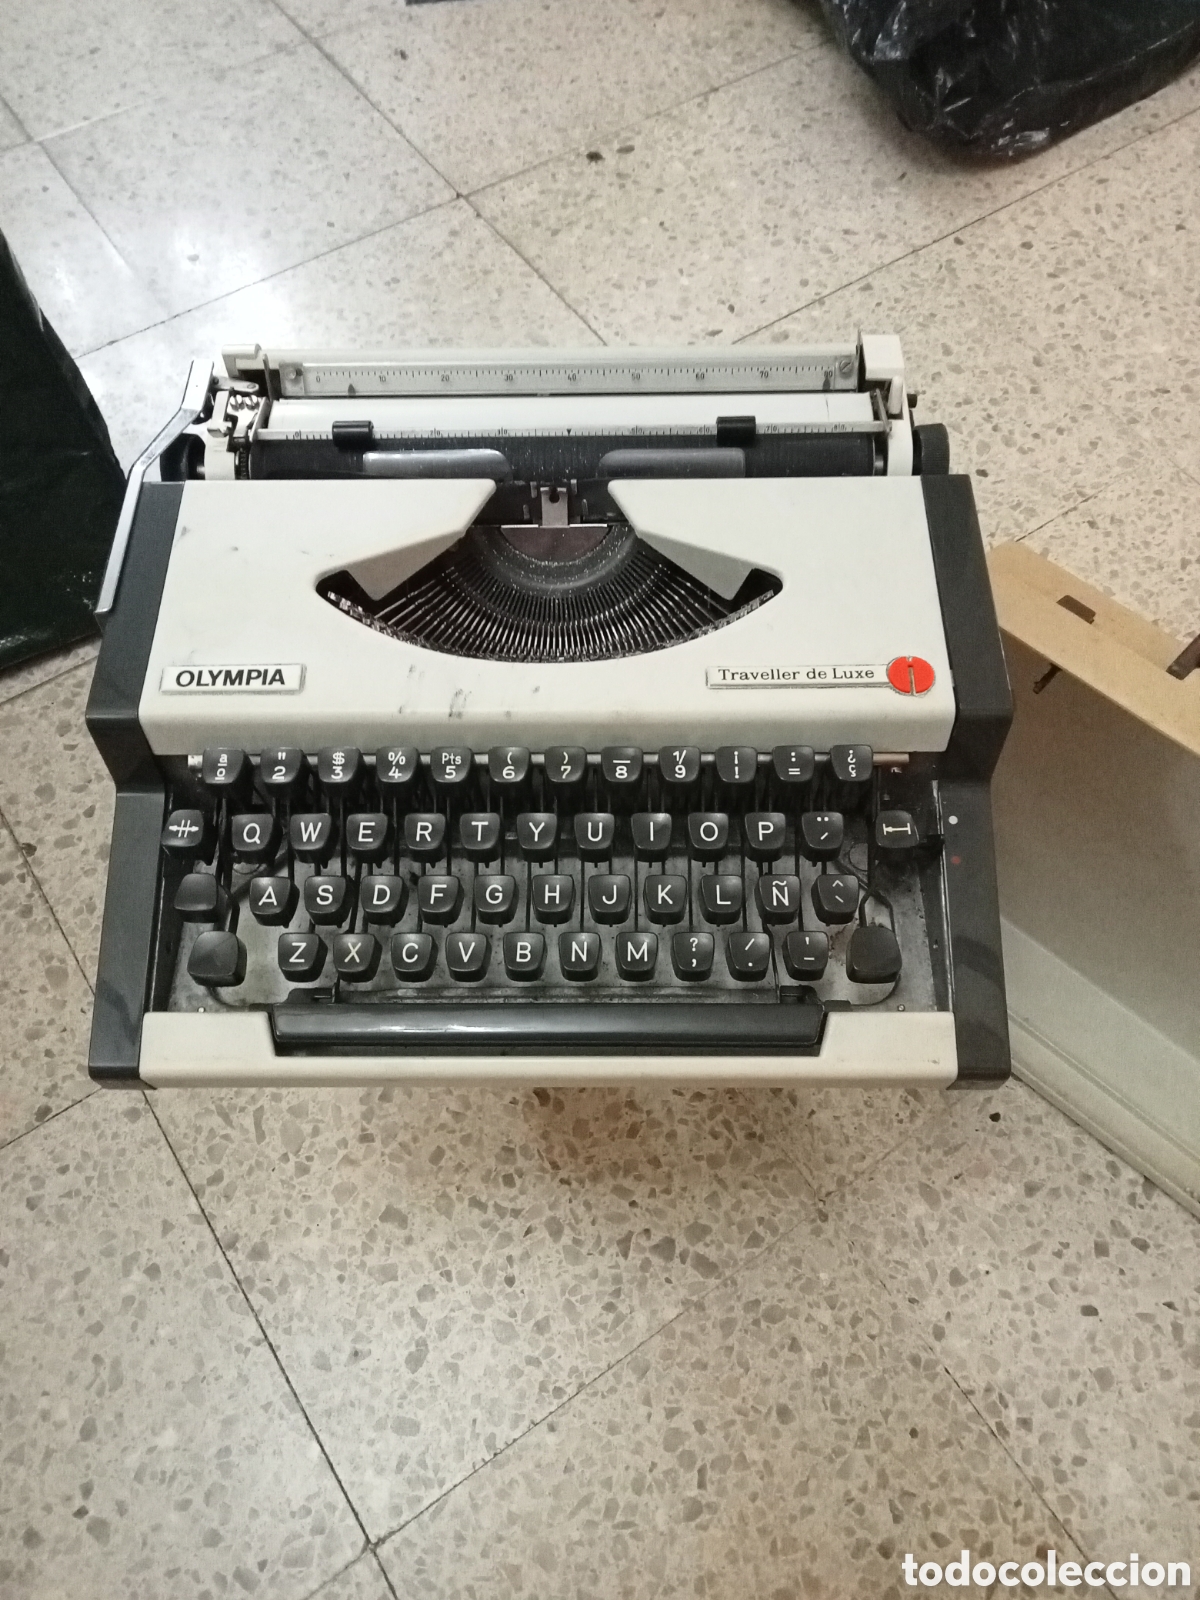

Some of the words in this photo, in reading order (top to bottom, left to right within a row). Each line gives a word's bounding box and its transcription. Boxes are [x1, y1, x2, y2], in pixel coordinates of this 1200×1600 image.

[379, 374, 387, 383] 10
[441, 374, 450, 382] 20
[175, 668, 286, 688] OLYMPIA
[718, 667, 801, 681] Traveller
[806, 668, 828, 680] de
[832, 666, 875, 680] Luxe
[331, 752, 346, 765] $
[387, 751, 407, 765] %
[441, 752, 462, 765] Pts
[507, 751, 513, 765] (
[563, 751, 569, 765] )
[271, 766, 286, 780] 2
[330, 766, 344, 779] 3
[388, 766, 402, 779] 4
[444, 766, 457, 779] 5
[502, 765, 515, 779] 6
[560, 766, 571, 778] 7
[615, 766, 628, 778] 8
[674, 765, 687, 778] 9
[242, 822, 262, 845] Q
[300, 821, 322, 842] W
[358, 821, 376, 842] E
[415, 821, 433, 842] R
[471, 821, 489, 842] T
[528, 821, 546, 842] Y
[586, 821, 604, 842] U
[649, 821, 655, 842] I
[699, 820, 720, 842] O
[758, 820, 775, 842] P
[258, 885, 278, 907] A
[316, 884, 334, 906] S
[372, 884, 391, 906] D
[429, 883, 448, 906] F
[485, 883, 504, 905] G
[543, 883, 561, 905] H
[601, 883, 618, 905] J
[657, 883, 674, 905] K
[715, 883, 732, 905] L
[772, 880, 790, 907] Ñ
[289, 942, 305, 963] Z
[343, 942, 361, 963] X
[401, 942, 419, 963] C
[458, 942, 475, 963] V
[516, 942, 532, 963] B
[571, 940, 588, 962] N
[627, 940, 648, 962] M
[690, 937, 698, 952] ?
